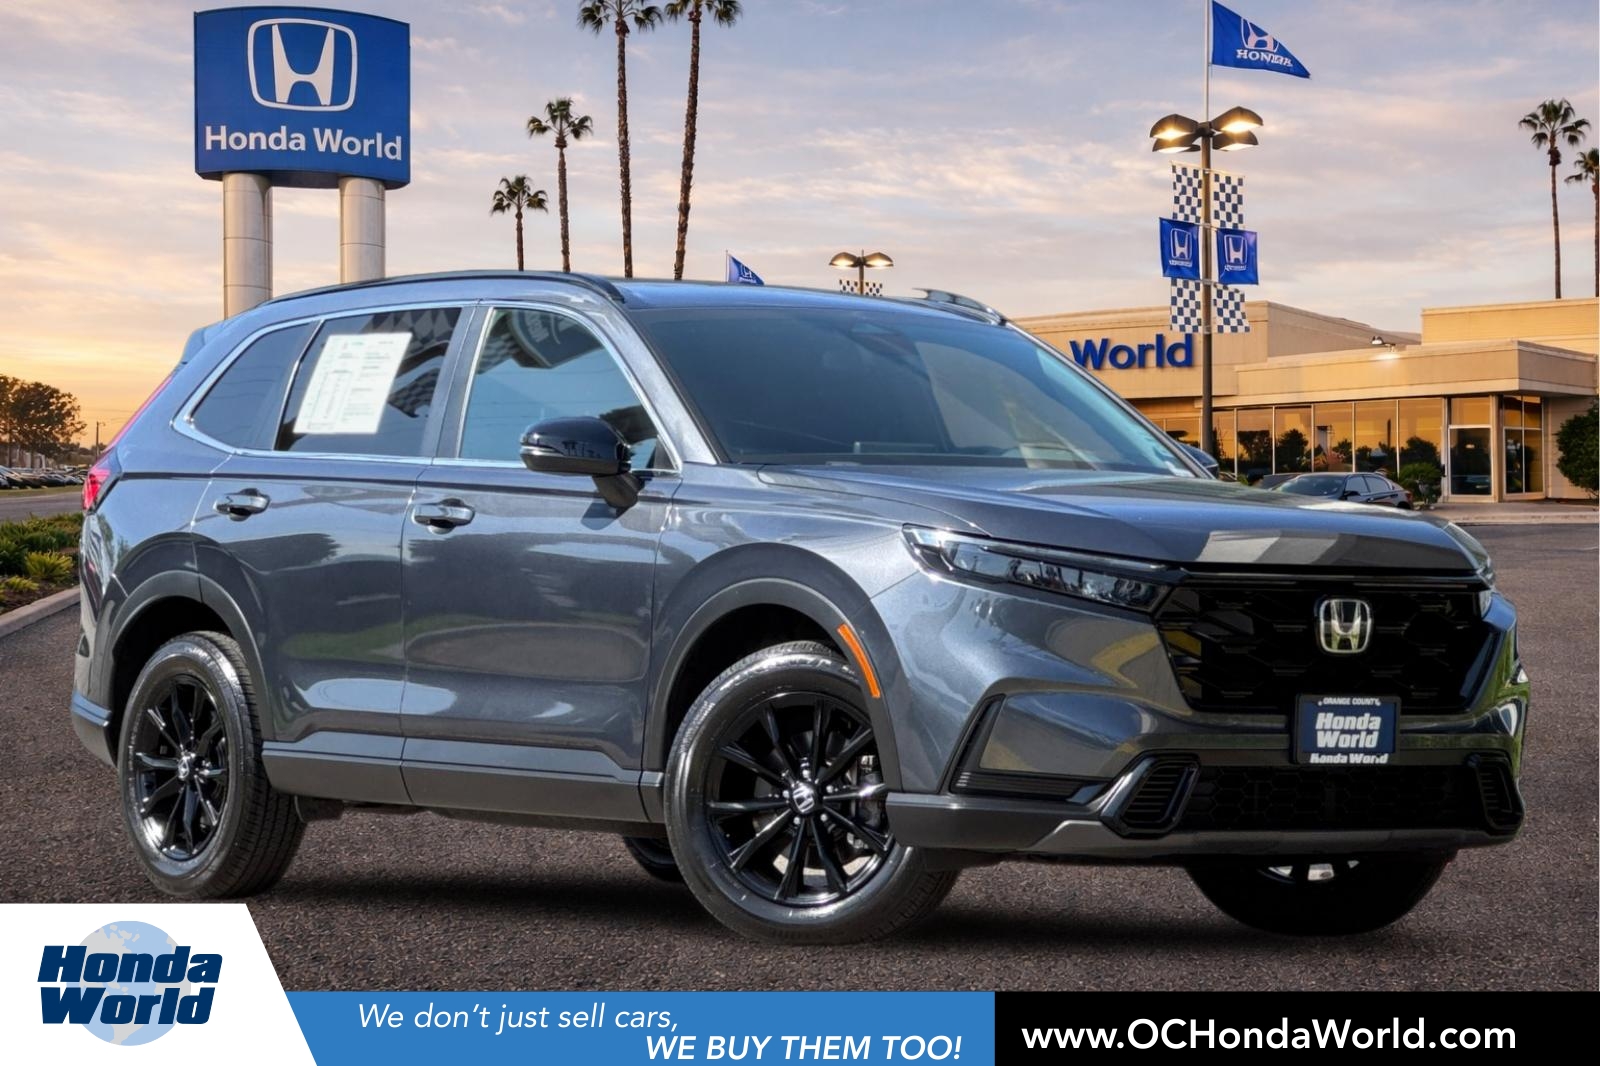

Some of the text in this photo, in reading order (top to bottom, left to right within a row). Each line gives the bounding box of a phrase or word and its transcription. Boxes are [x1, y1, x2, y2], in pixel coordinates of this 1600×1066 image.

[205, 125, 402, 160] Honda World
[1069, 333, 1193, 370] World
[1315, 712, 1382, 730] Honda
[1316, 730, 1379, 748] World
[1309, 753, 1389, 764] Honda World
